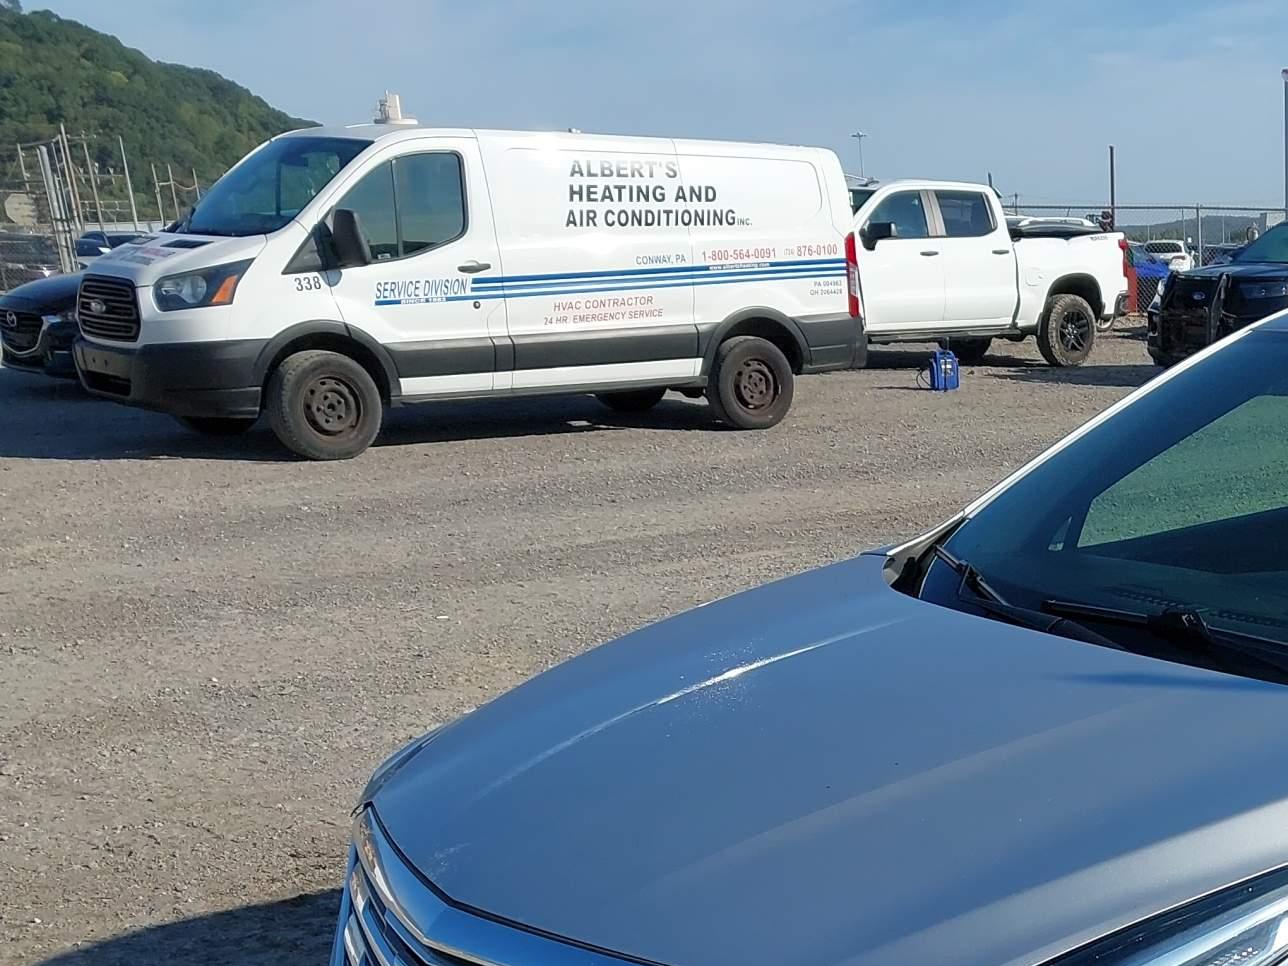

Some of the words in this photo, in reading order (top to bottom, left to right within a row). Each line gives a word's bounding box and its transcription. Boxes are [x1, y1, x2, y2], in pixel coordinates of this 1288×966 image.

[569, 160, 678, 179] ALBERT'S
[568, 184, 666, 203] HEATING
[674, 185, 717, 203] AND
[565, 209, 598, 227] AIR
[604, 209, 736, 227] CONDITIONING
[737, 218, 753, 226] INC.
[635, 255, 674, 265] CONWAY,
[675, 254, 687, 263] PA
[701, 247, 777, 262] 1-800-564-0091
[796, 243, 838, 257] 876-0100
[294, 275, 322, 291] 338
[375, 280, 421, 299] SERVICE
[423, 278, 468, 297] DIVISION
[553, 300, 581, 312] HVAC
[584, 295, 654, 310] CONTRACTOR
[543, 317, 554, 326] 24
[572, 311, 626, 324] EMERGENCY
[627, 308, 664, 319] SERVICE
